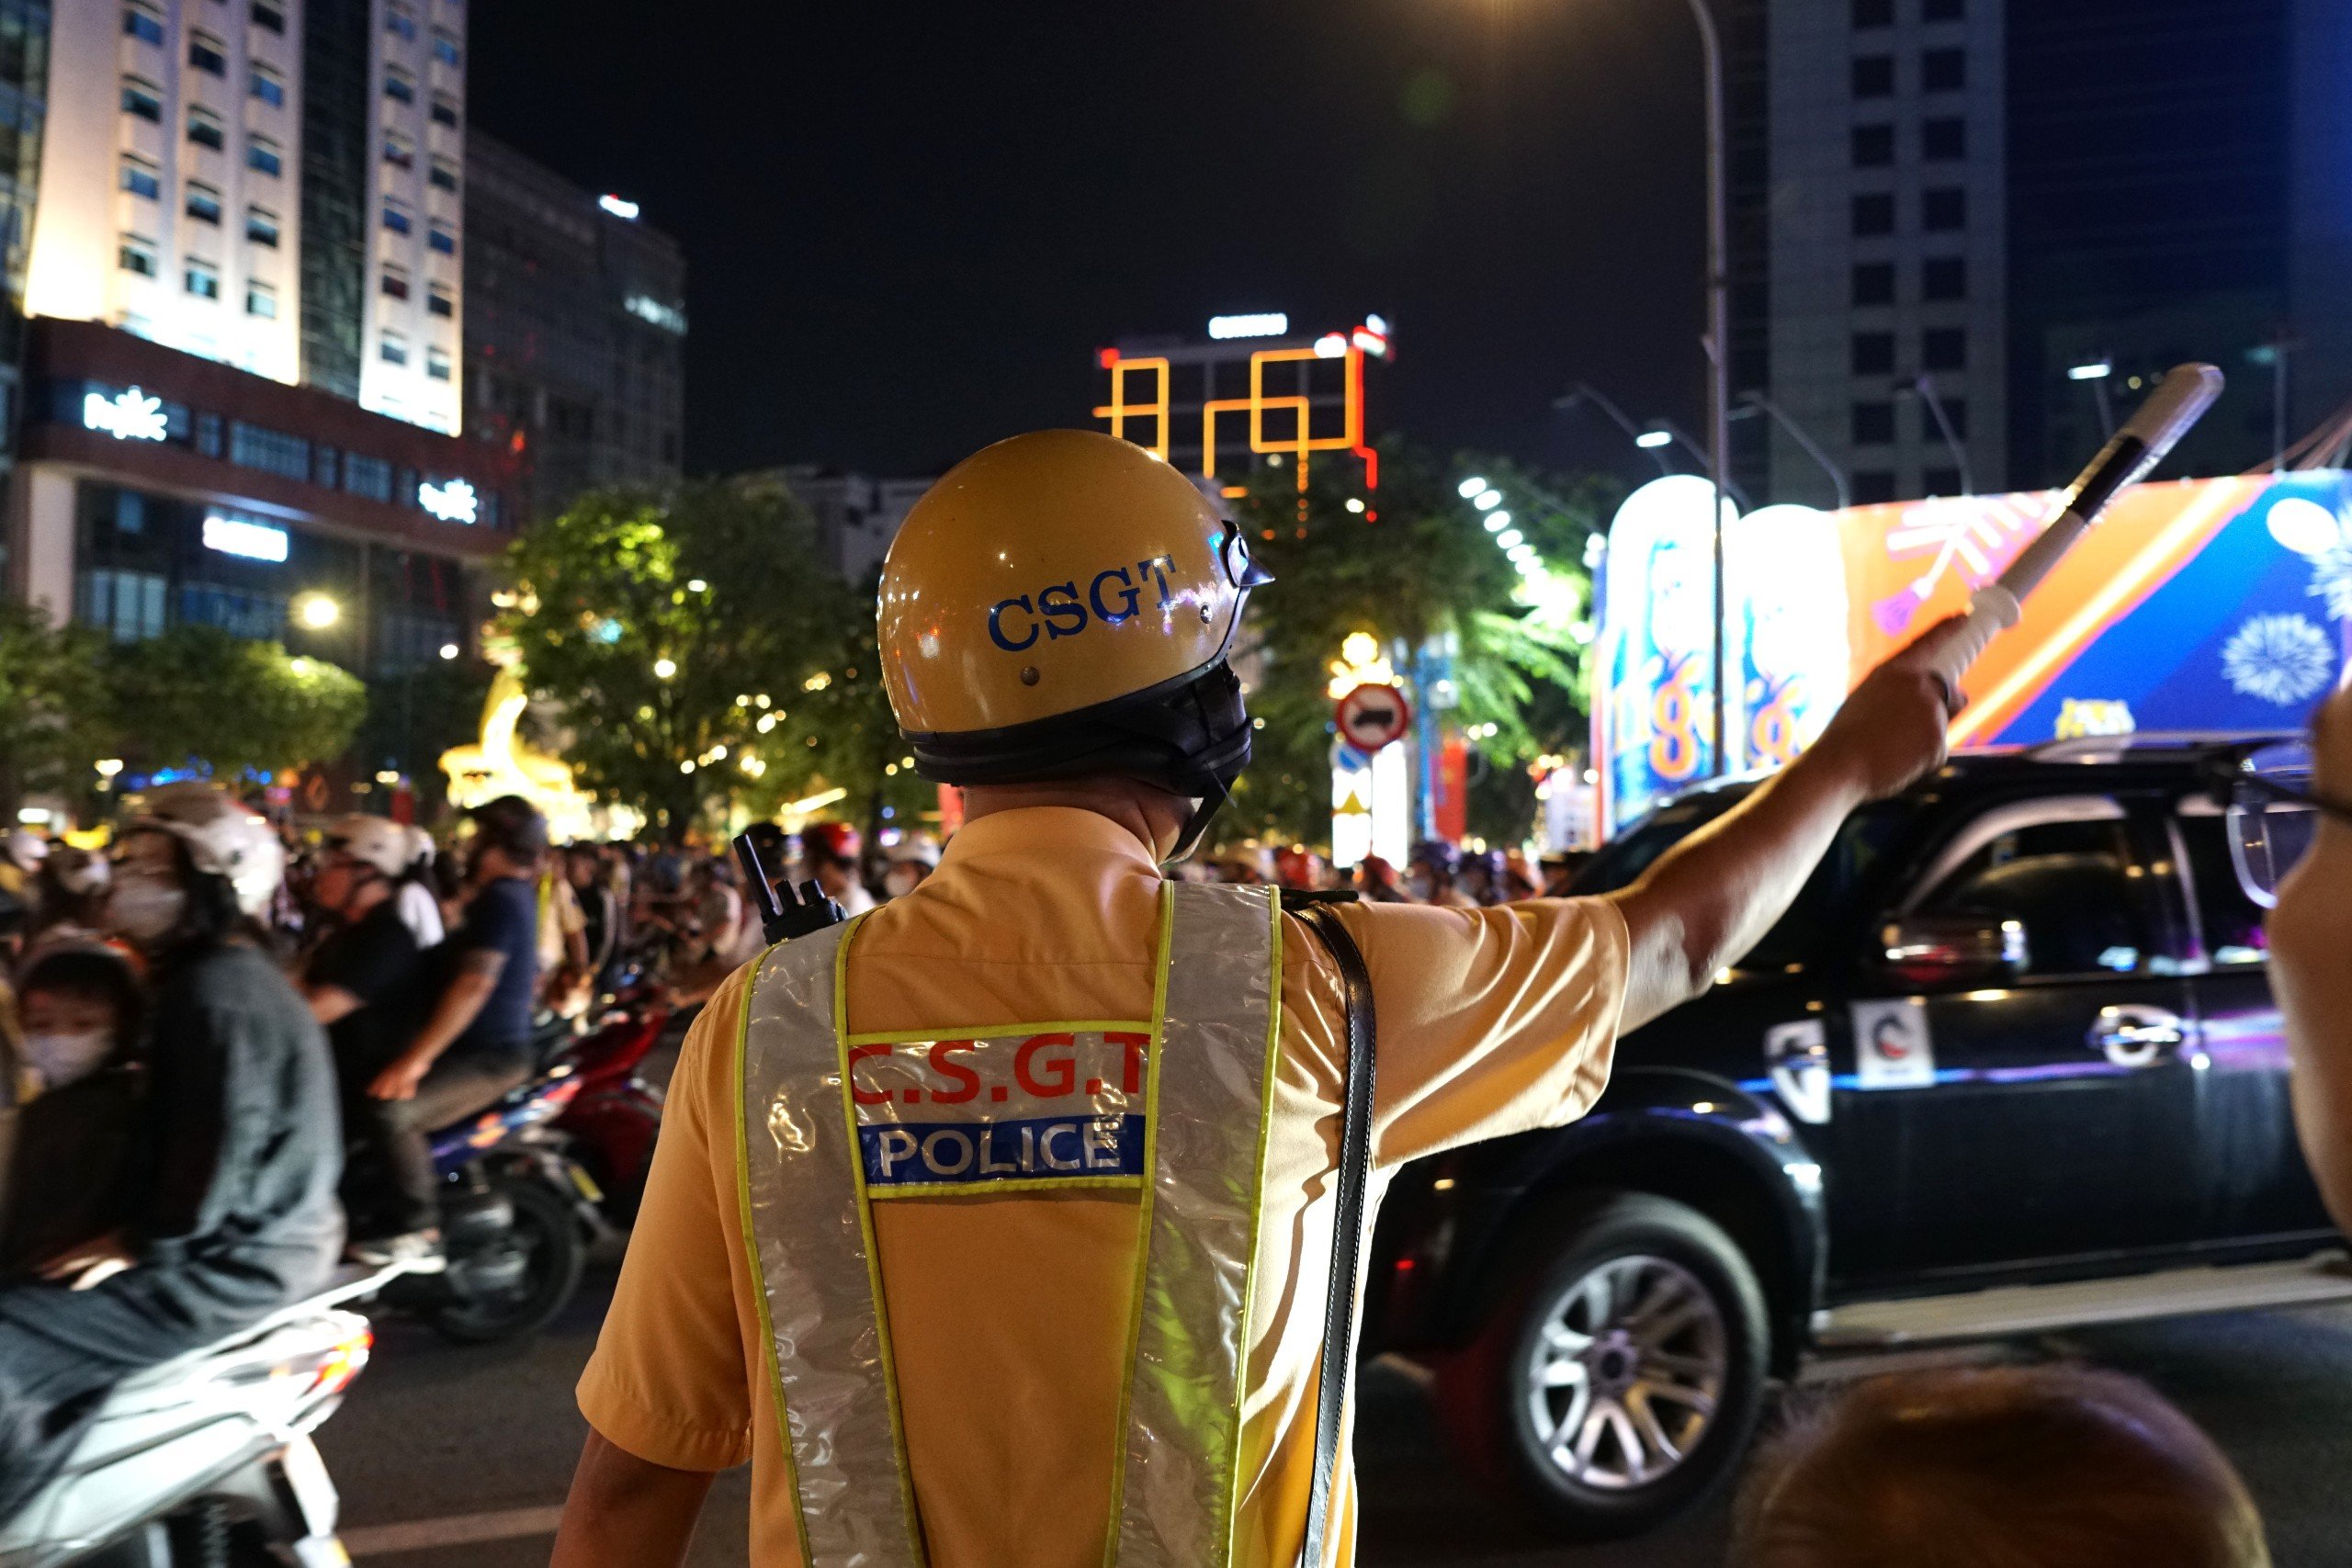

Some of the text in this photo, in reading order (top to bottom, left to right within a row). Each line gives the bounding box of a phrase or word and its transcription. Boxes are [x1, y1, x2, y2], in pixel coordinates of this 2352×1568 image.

[989, 554, 1177, 652] CSGT
[847, 1031, 1151, 1105] C.S.G.T
[878, 1121, 1121, 1177] POLICE
